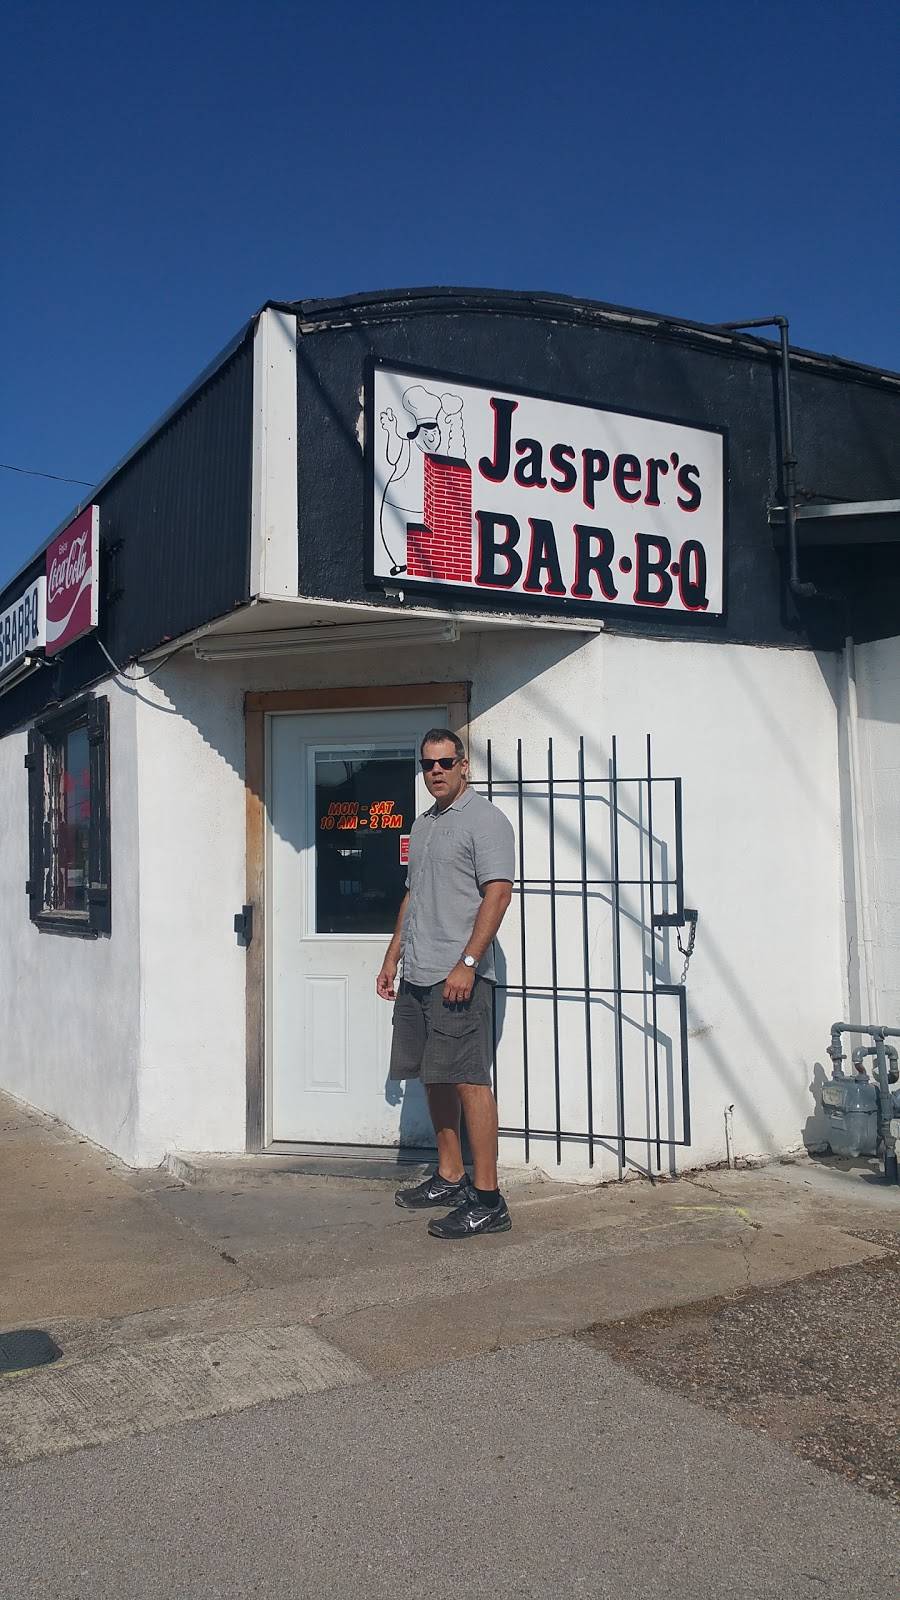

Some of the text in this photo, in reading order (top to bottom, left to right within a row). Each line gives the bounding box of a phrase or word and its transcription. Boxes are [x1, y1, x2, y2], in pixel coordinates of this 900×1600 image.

[478, 397, 702, 513] Jasper's
[328, 801, 359, 815] MON
[369, 801, 394, 815] SAT
[320, 816, 335, 829] 10
[337, 816, 358, 829] AM
[370, 815, 378, 829] 2
[381, 815, 403, 828] PM
